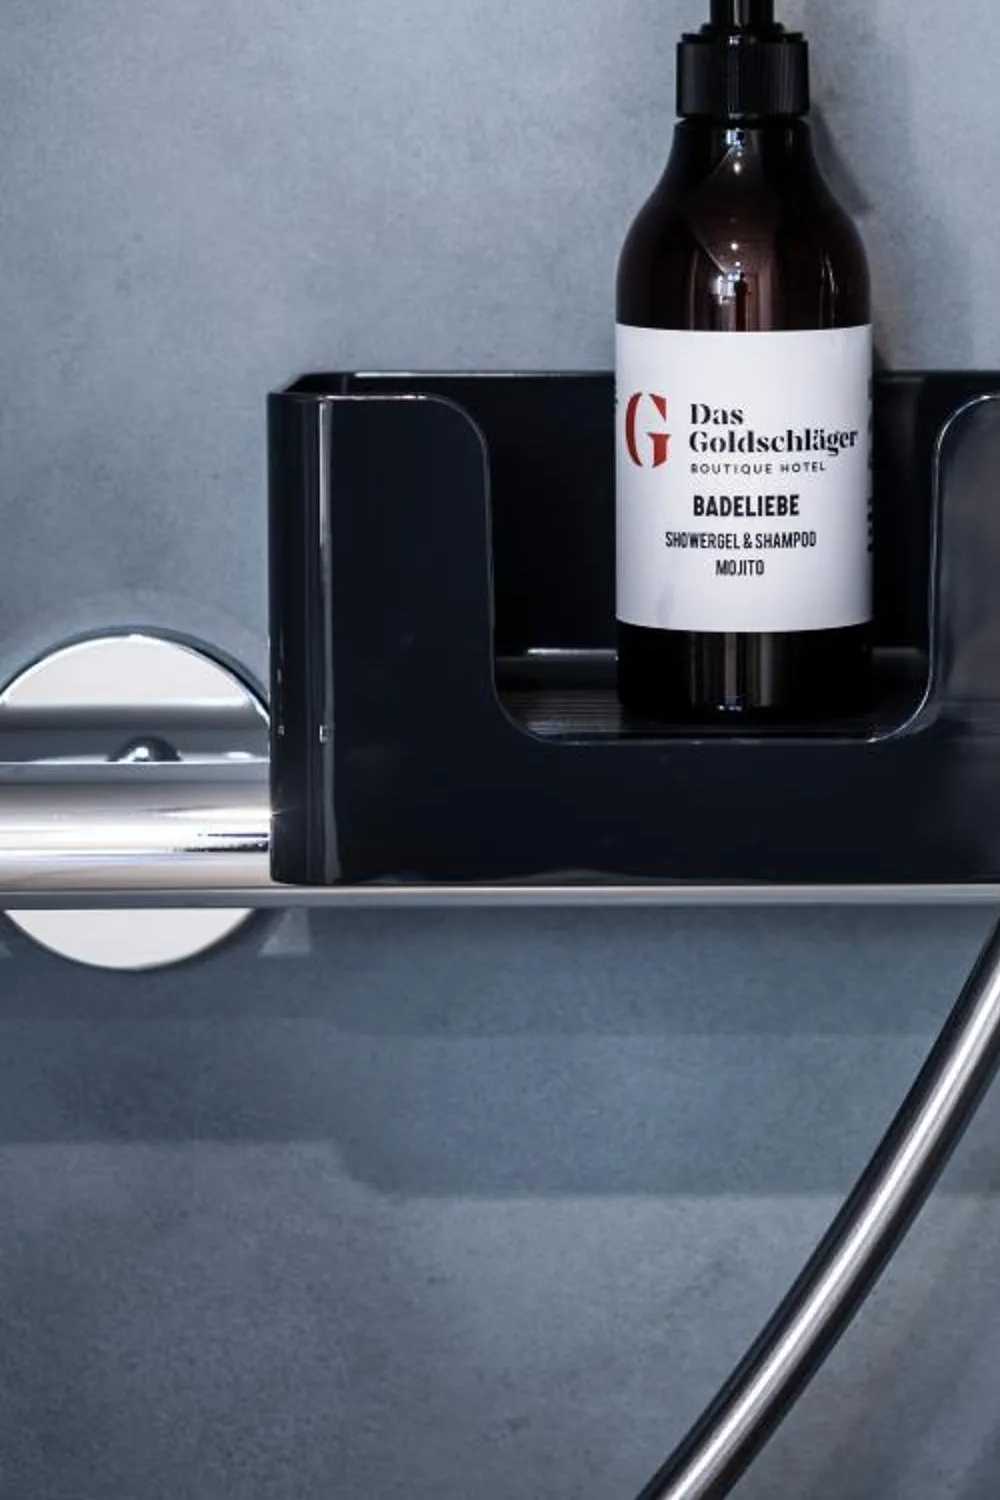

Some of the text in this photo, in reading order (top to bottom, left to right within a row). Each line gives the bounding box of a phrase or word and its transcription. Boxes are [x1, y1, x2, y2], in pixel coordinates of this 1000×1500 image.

[690, 403, 744, 425] Das
[624, 391, 671, 469] G
[689, 428, 859, 457] Goldschläger
[690, 460, 827, 476] BOUTIQUE HOTEL
[693, 493, 800, 517] BADELIEBE
[665, 530, 817, 550] SHOWERGEL & SHAMPOO
[715, 559, 765, 577] MOJITO
